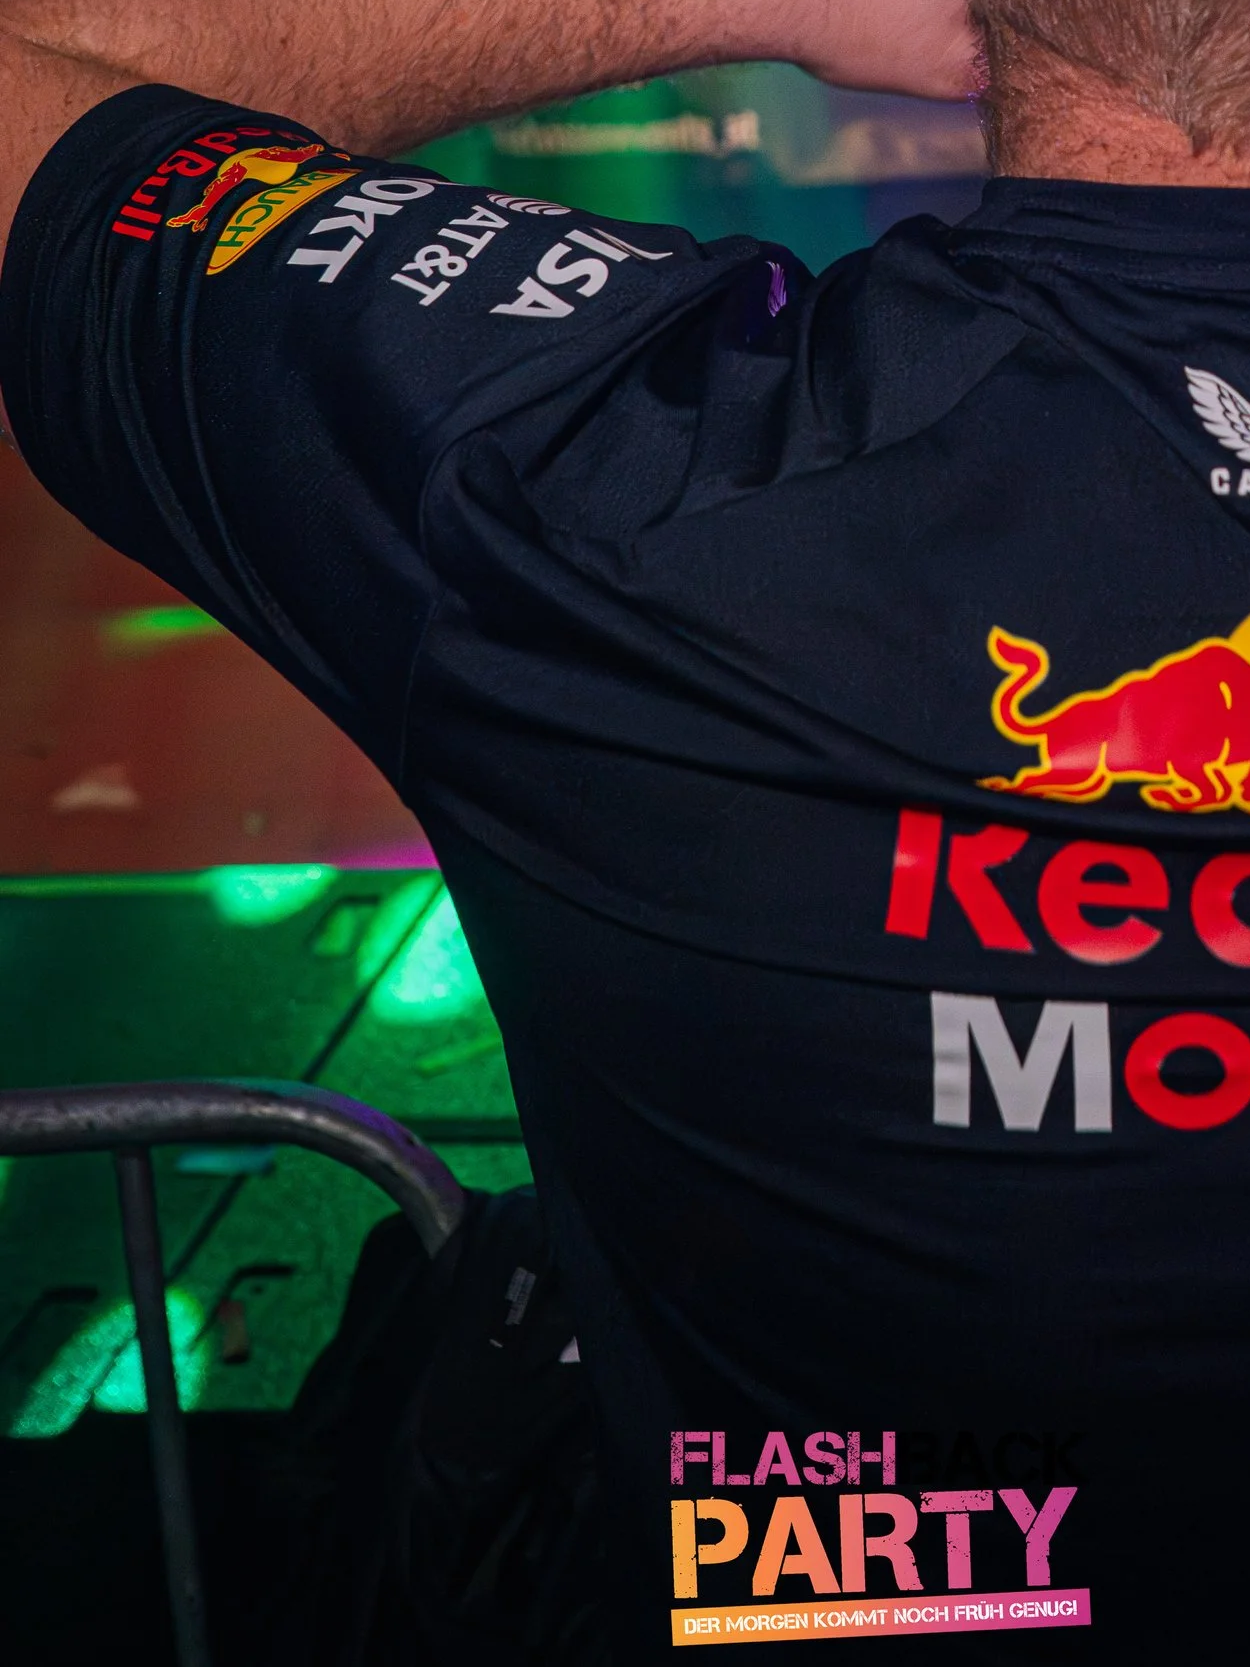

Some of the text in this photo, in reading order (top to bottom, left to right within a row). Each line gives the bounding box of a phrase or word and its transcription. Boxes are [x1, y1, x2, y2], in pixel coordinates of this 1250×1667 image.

[111, 148, 217, 242] Bull
[215, 170, 335, 248] RAUCH
[286, 177, 450, 284] OKT
[390, 204, 510, 307] AT&T
